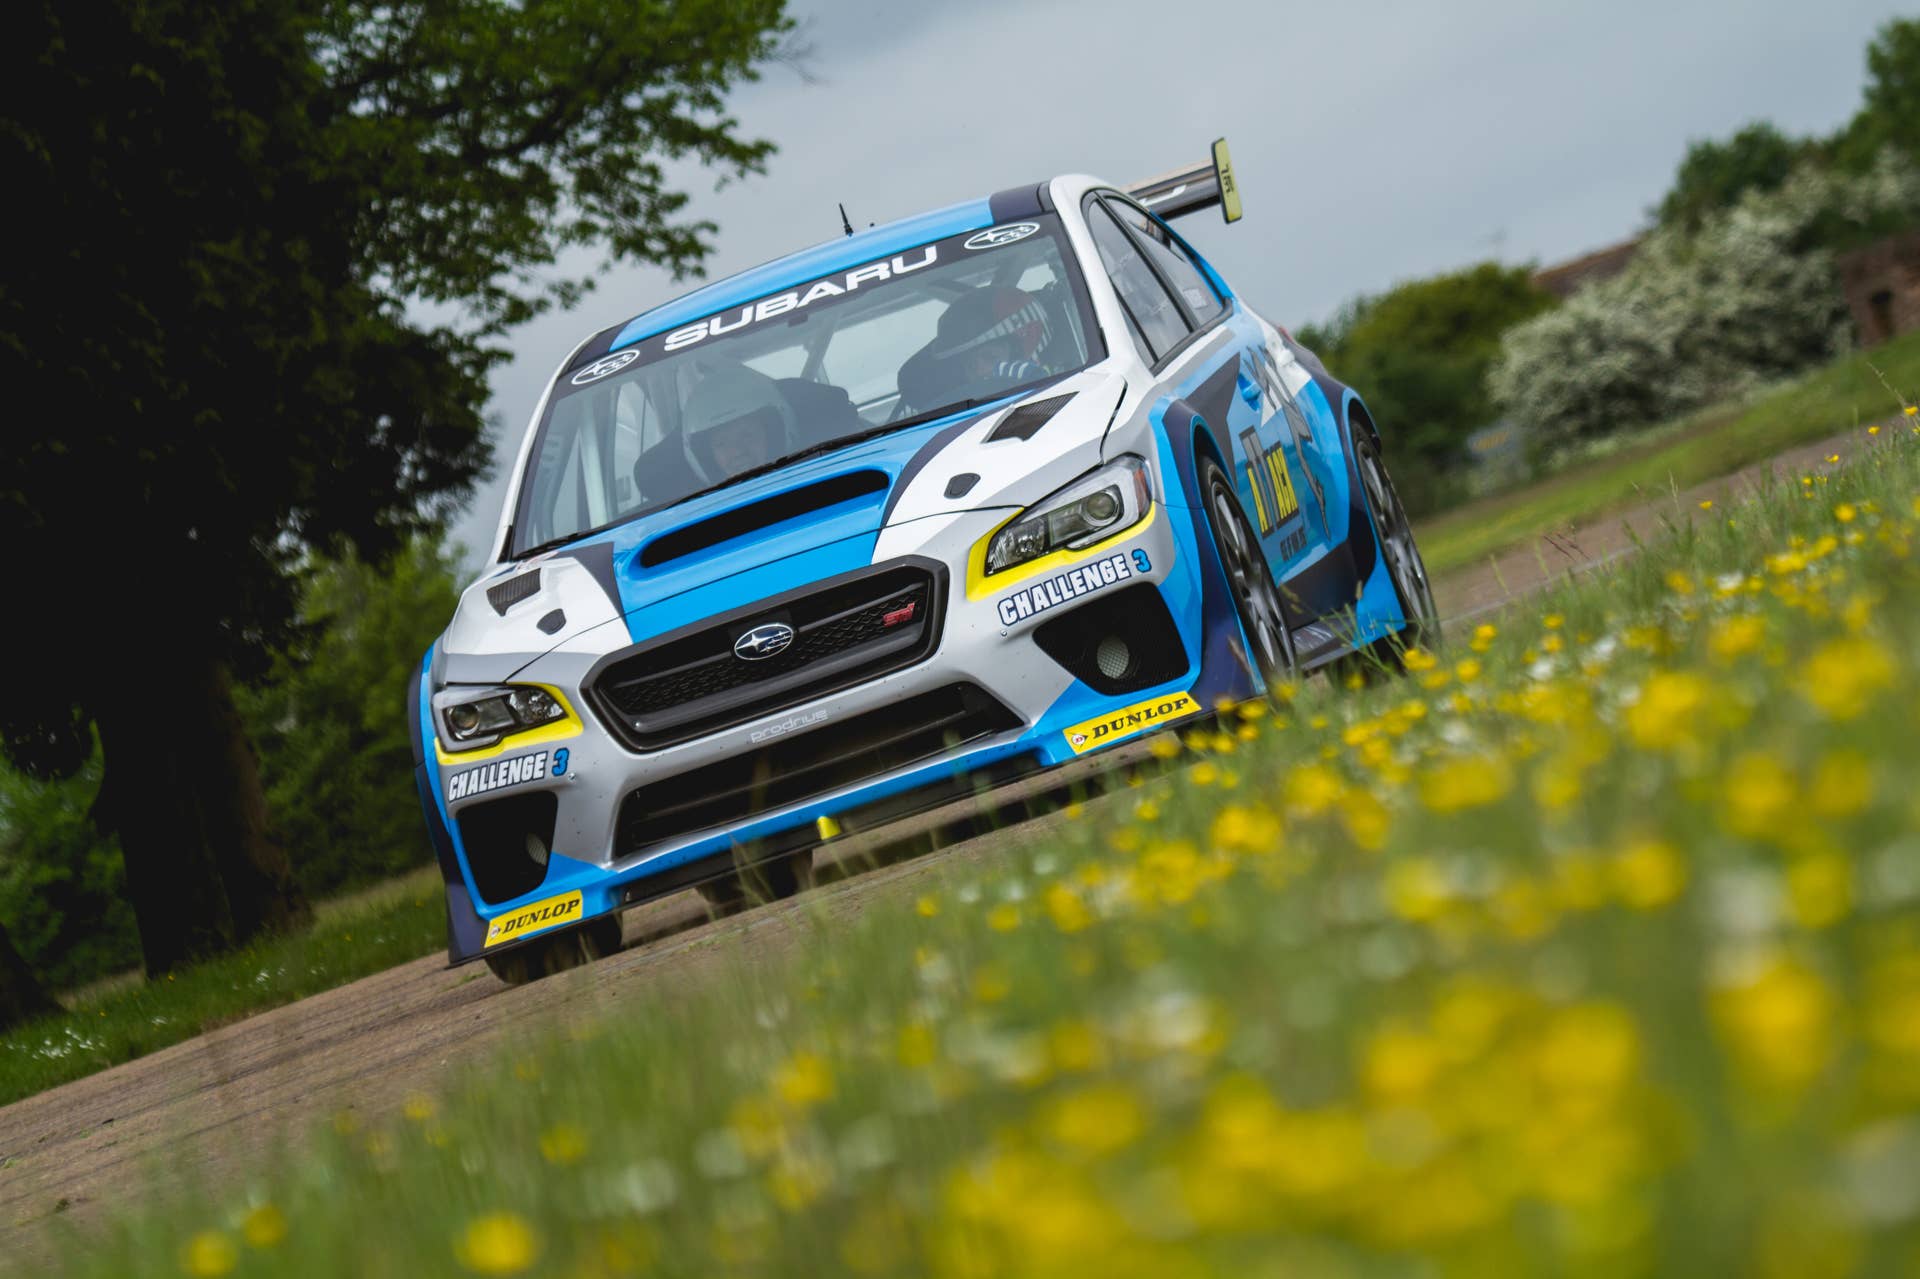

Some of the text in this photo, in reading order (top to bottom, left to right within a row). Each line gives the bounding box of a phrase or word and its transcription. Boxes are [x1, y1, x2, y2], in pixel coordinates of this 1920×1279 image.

[664, 246, 936, 352] SUBARU
[997, 548, 1152, 626] CHALLENGE 3
[750, 709, 828, 743] prodrive
[1092, 697, 1189, 739] DUNLOP
[449, 747, 570, 802] CHALLENGE 3
[502, 898, 581, 935] DUNLOP
